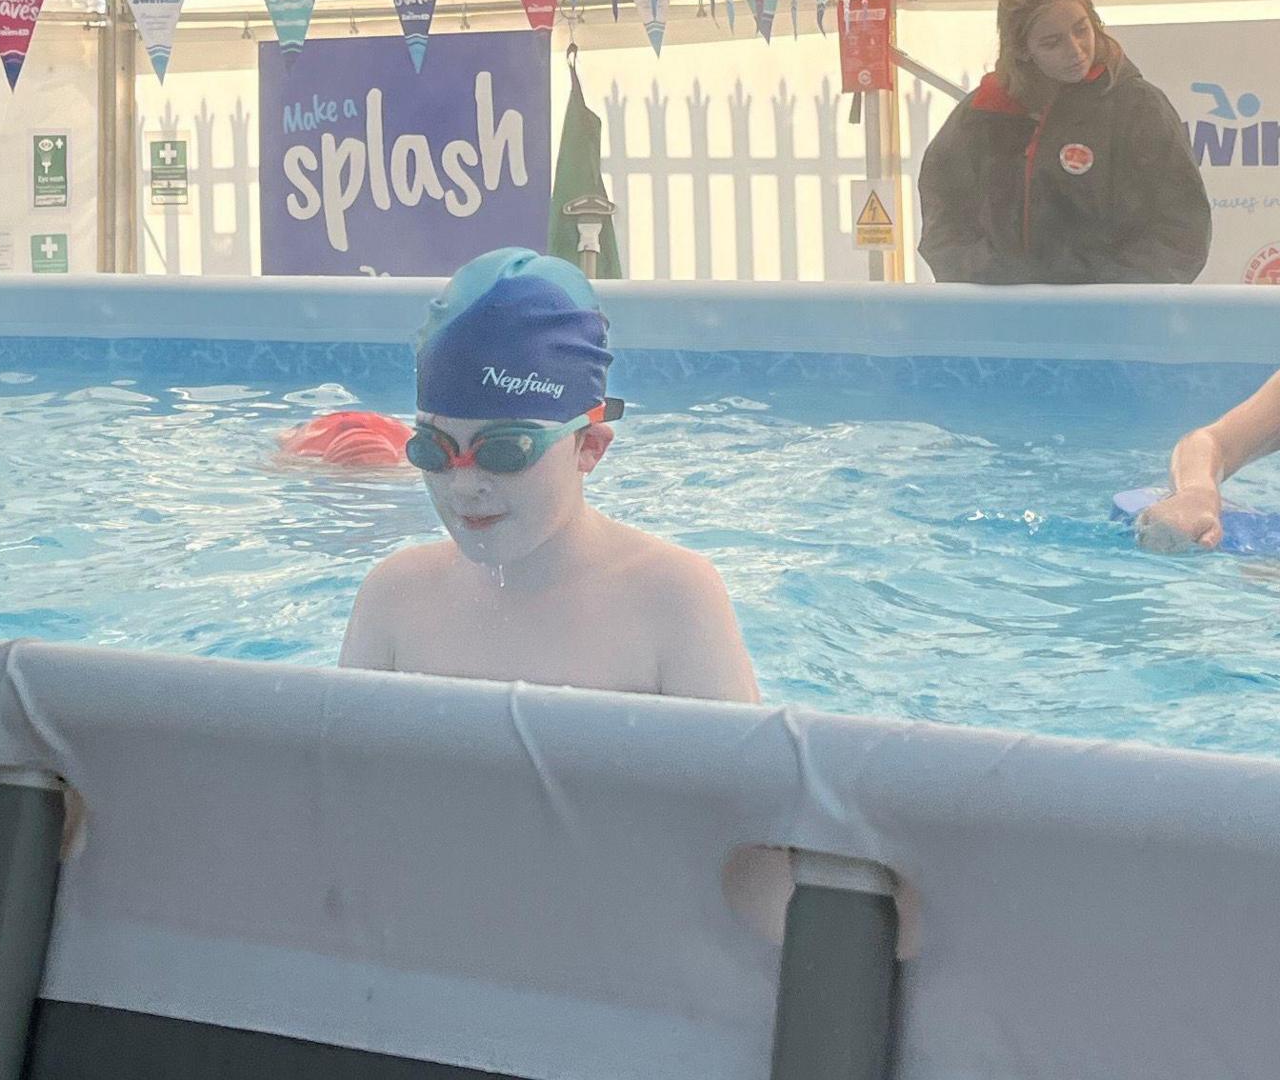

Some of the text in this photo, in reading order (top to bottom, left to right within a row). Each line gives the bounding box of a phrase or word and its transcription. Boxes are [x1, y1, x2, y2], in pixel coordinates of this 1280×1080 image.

[283, 94, 358, 134] Make a
[283, 71, 528, 252] splash
